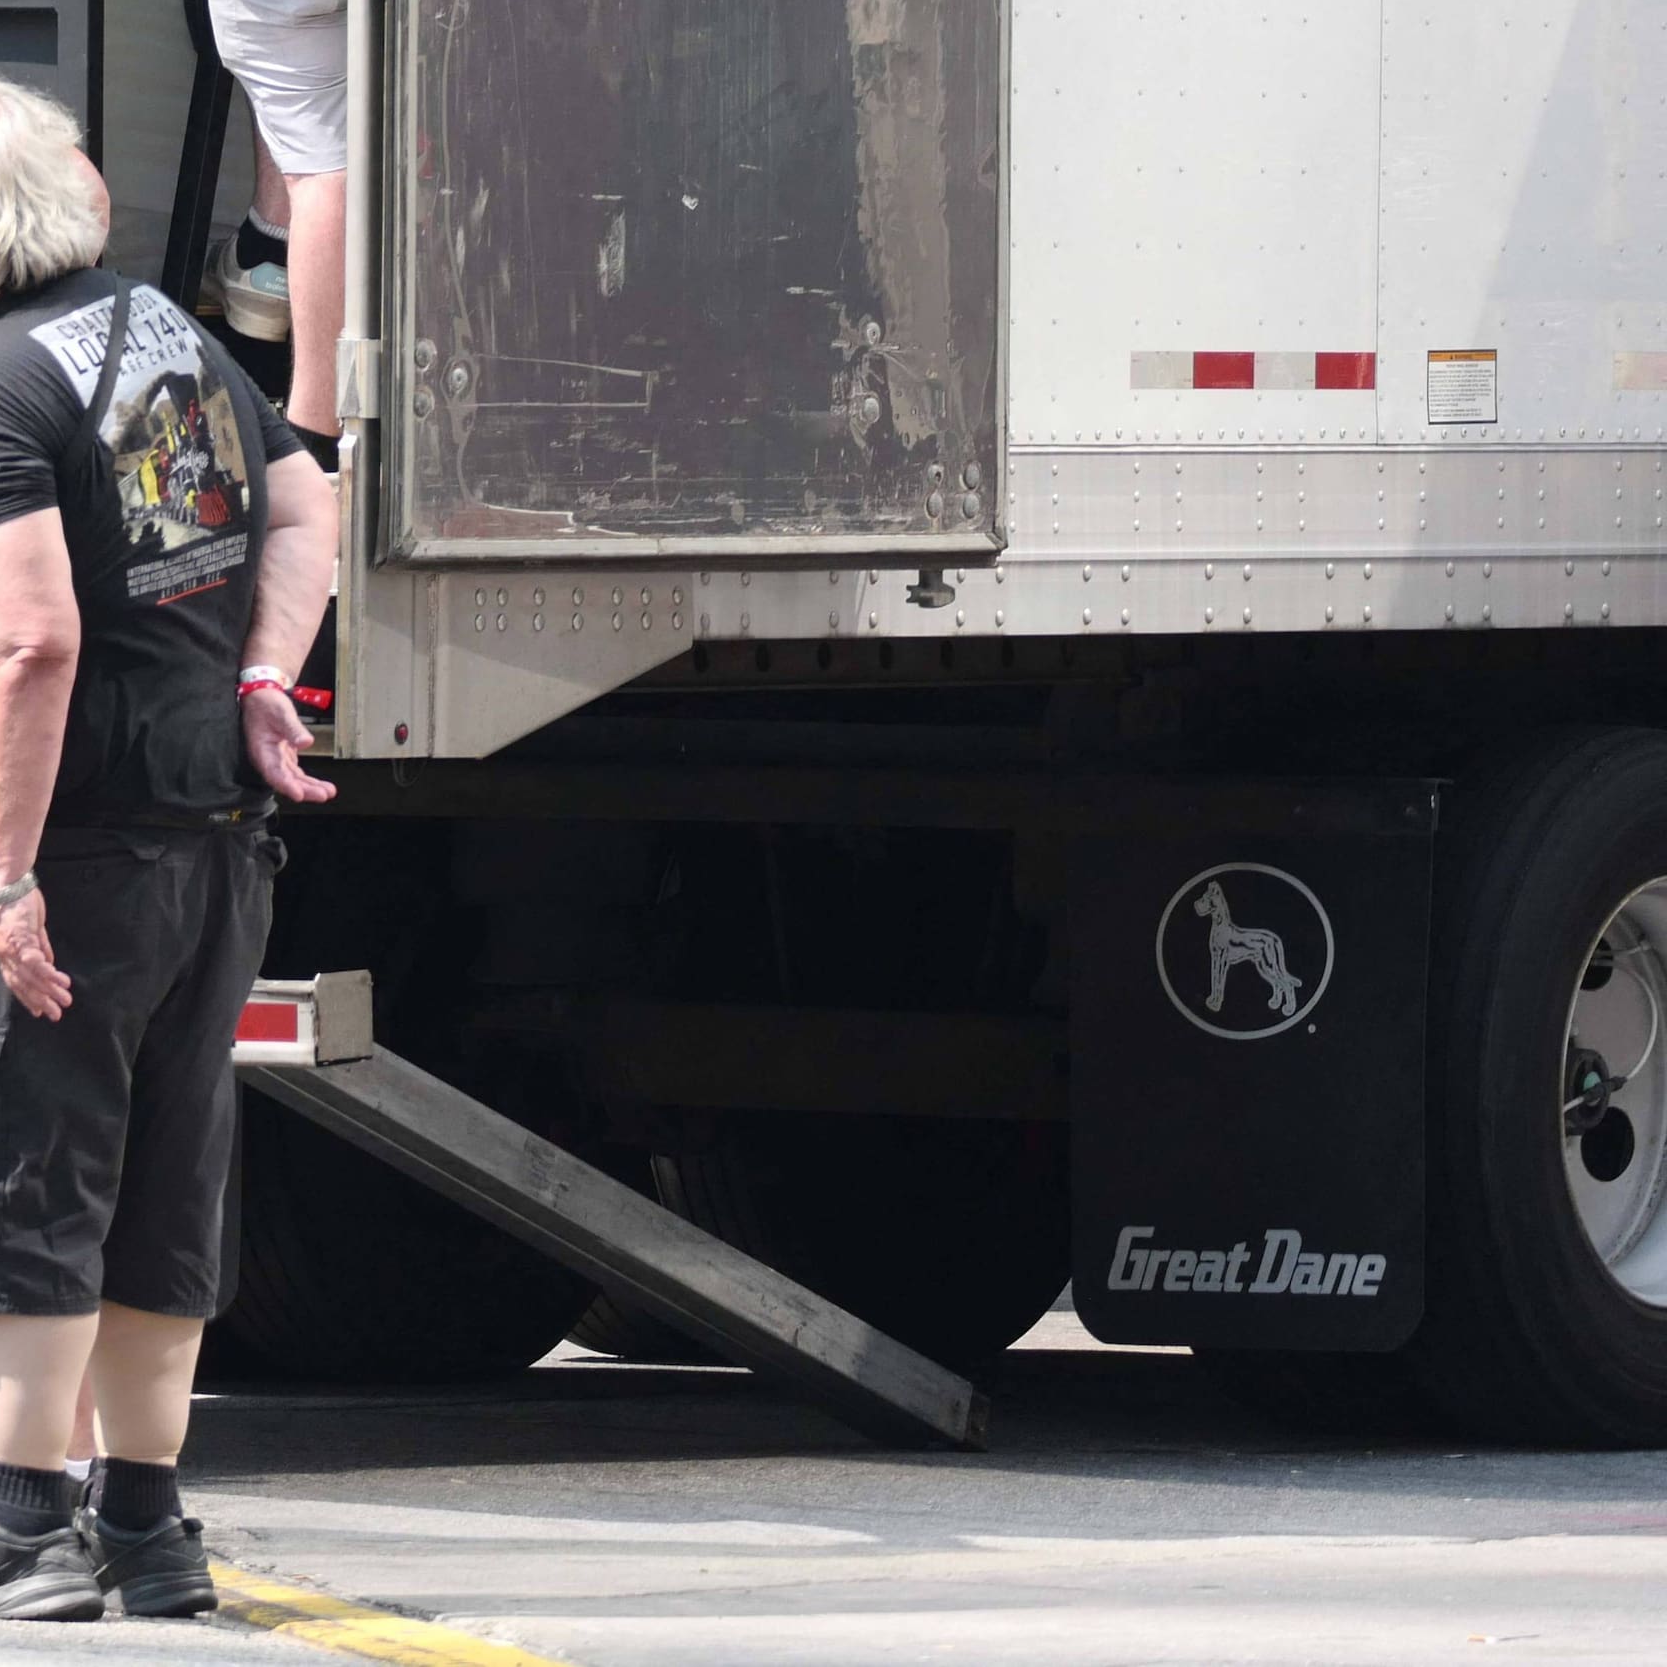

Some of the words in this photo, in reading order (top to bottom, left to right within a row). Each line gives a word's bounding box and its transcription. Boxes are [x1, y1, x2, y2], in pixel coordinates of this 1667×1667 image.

[144, 307, 188, 345] 140
[148, 337, 189, 366] CREW
[1107, 1225, 1247, 1294] Great
[1248, 1228, 1387, 1296] Dane
